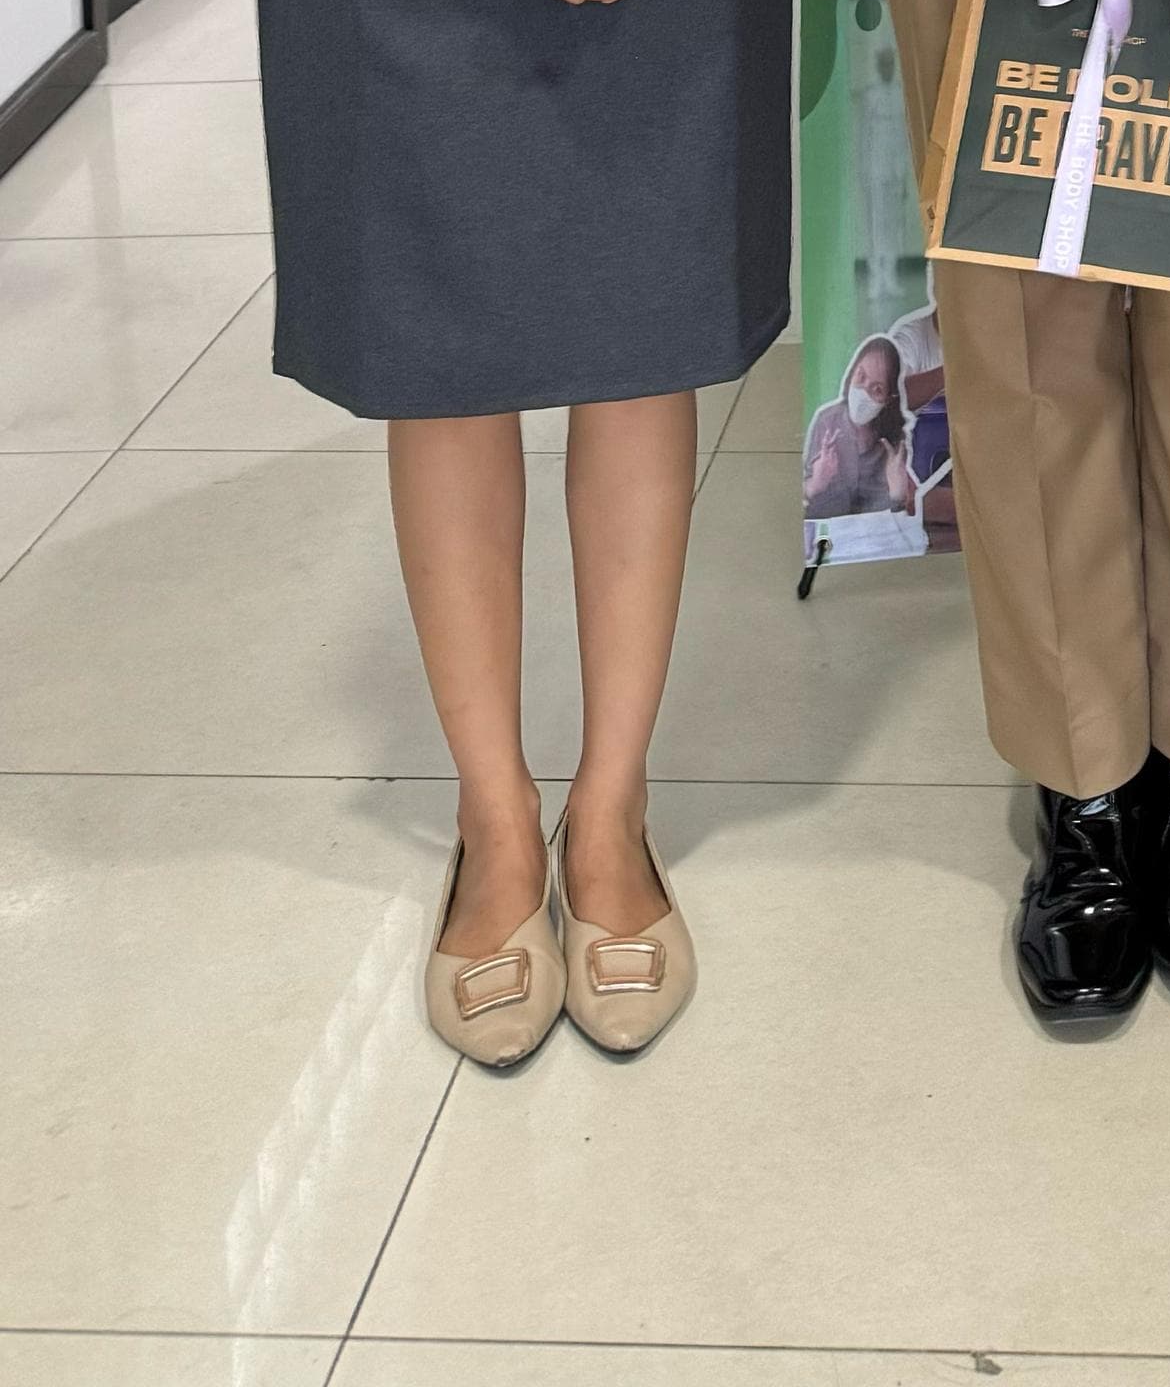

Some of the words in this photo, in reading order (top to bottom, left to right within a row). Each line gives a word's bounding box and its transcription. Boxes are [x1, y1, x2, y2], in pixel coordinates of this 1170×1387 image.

[996, 59, 1062, 93] BE
[992, 105, 1049, 166] BE
[1076, 114, 1092, 148] THE
[1064, 157, 1087, 210] BODY
[1053, 214, 1076, 270] SHOP
